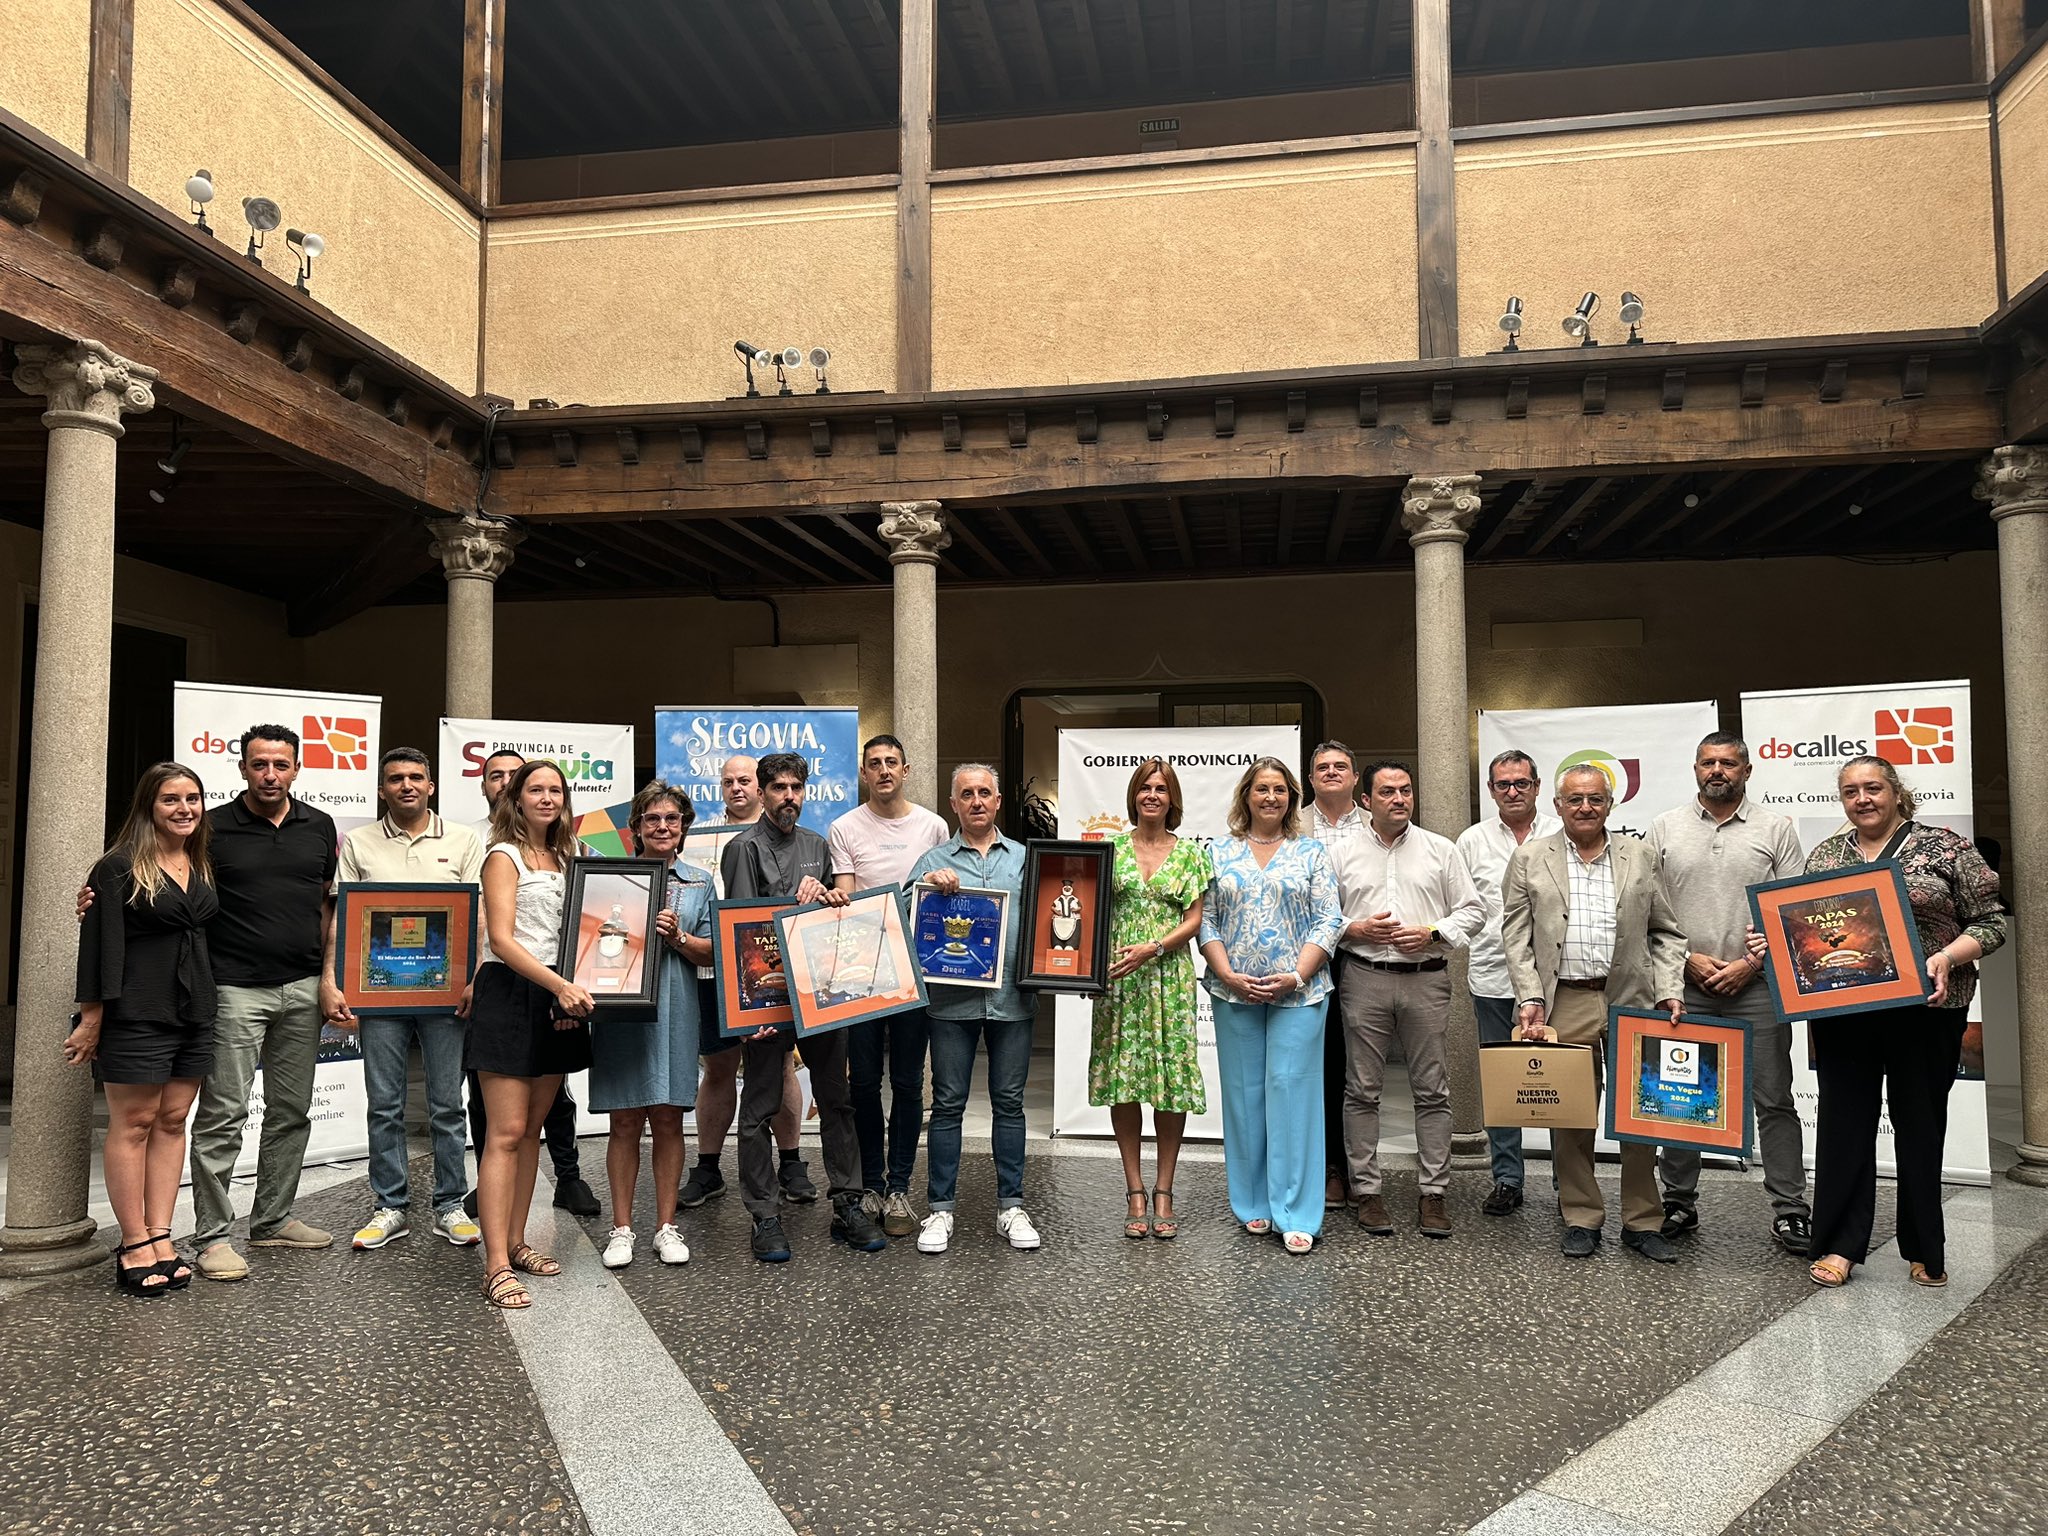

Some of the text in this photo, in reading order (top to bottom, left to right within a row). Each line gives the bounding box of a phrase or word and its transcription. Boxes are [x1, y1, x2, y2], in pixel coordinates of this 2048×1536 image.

[1142, 120, 1177, 132] SALIDA
[686, 717, 826, 756] SEGOVIA,
[492, 741, 574, 754] PROVINCIA DE
[1759, 735, 1868, 759] decalles
[690, 757, 722, 776] SAB
[204, 790, 225, 800] rea
[300, 792, 316, 802] de
[319, 792, 367, 806] Segovia
[681, 784, 723, 801] UENT
[805, 784, 846, 802] RIAS
[1761, 789, 1955, 804] Área Come govia
[1804, 908, 1857, 924] TAPAS
[1820, 919, 1845, 929] 2024
[753, 936, 778, 945] TAP
[824, 928, 867, 944] TAPAS
[941, 965, 966, 974] Duque
[1516, 1089, 1558, 1097] NUESTRO
[1658, 1083, 1703, 1095] Rte. Vogue
[1670, 1094, 1691, 1103] 2024
[309, 1110, 345, 1121] sonline
